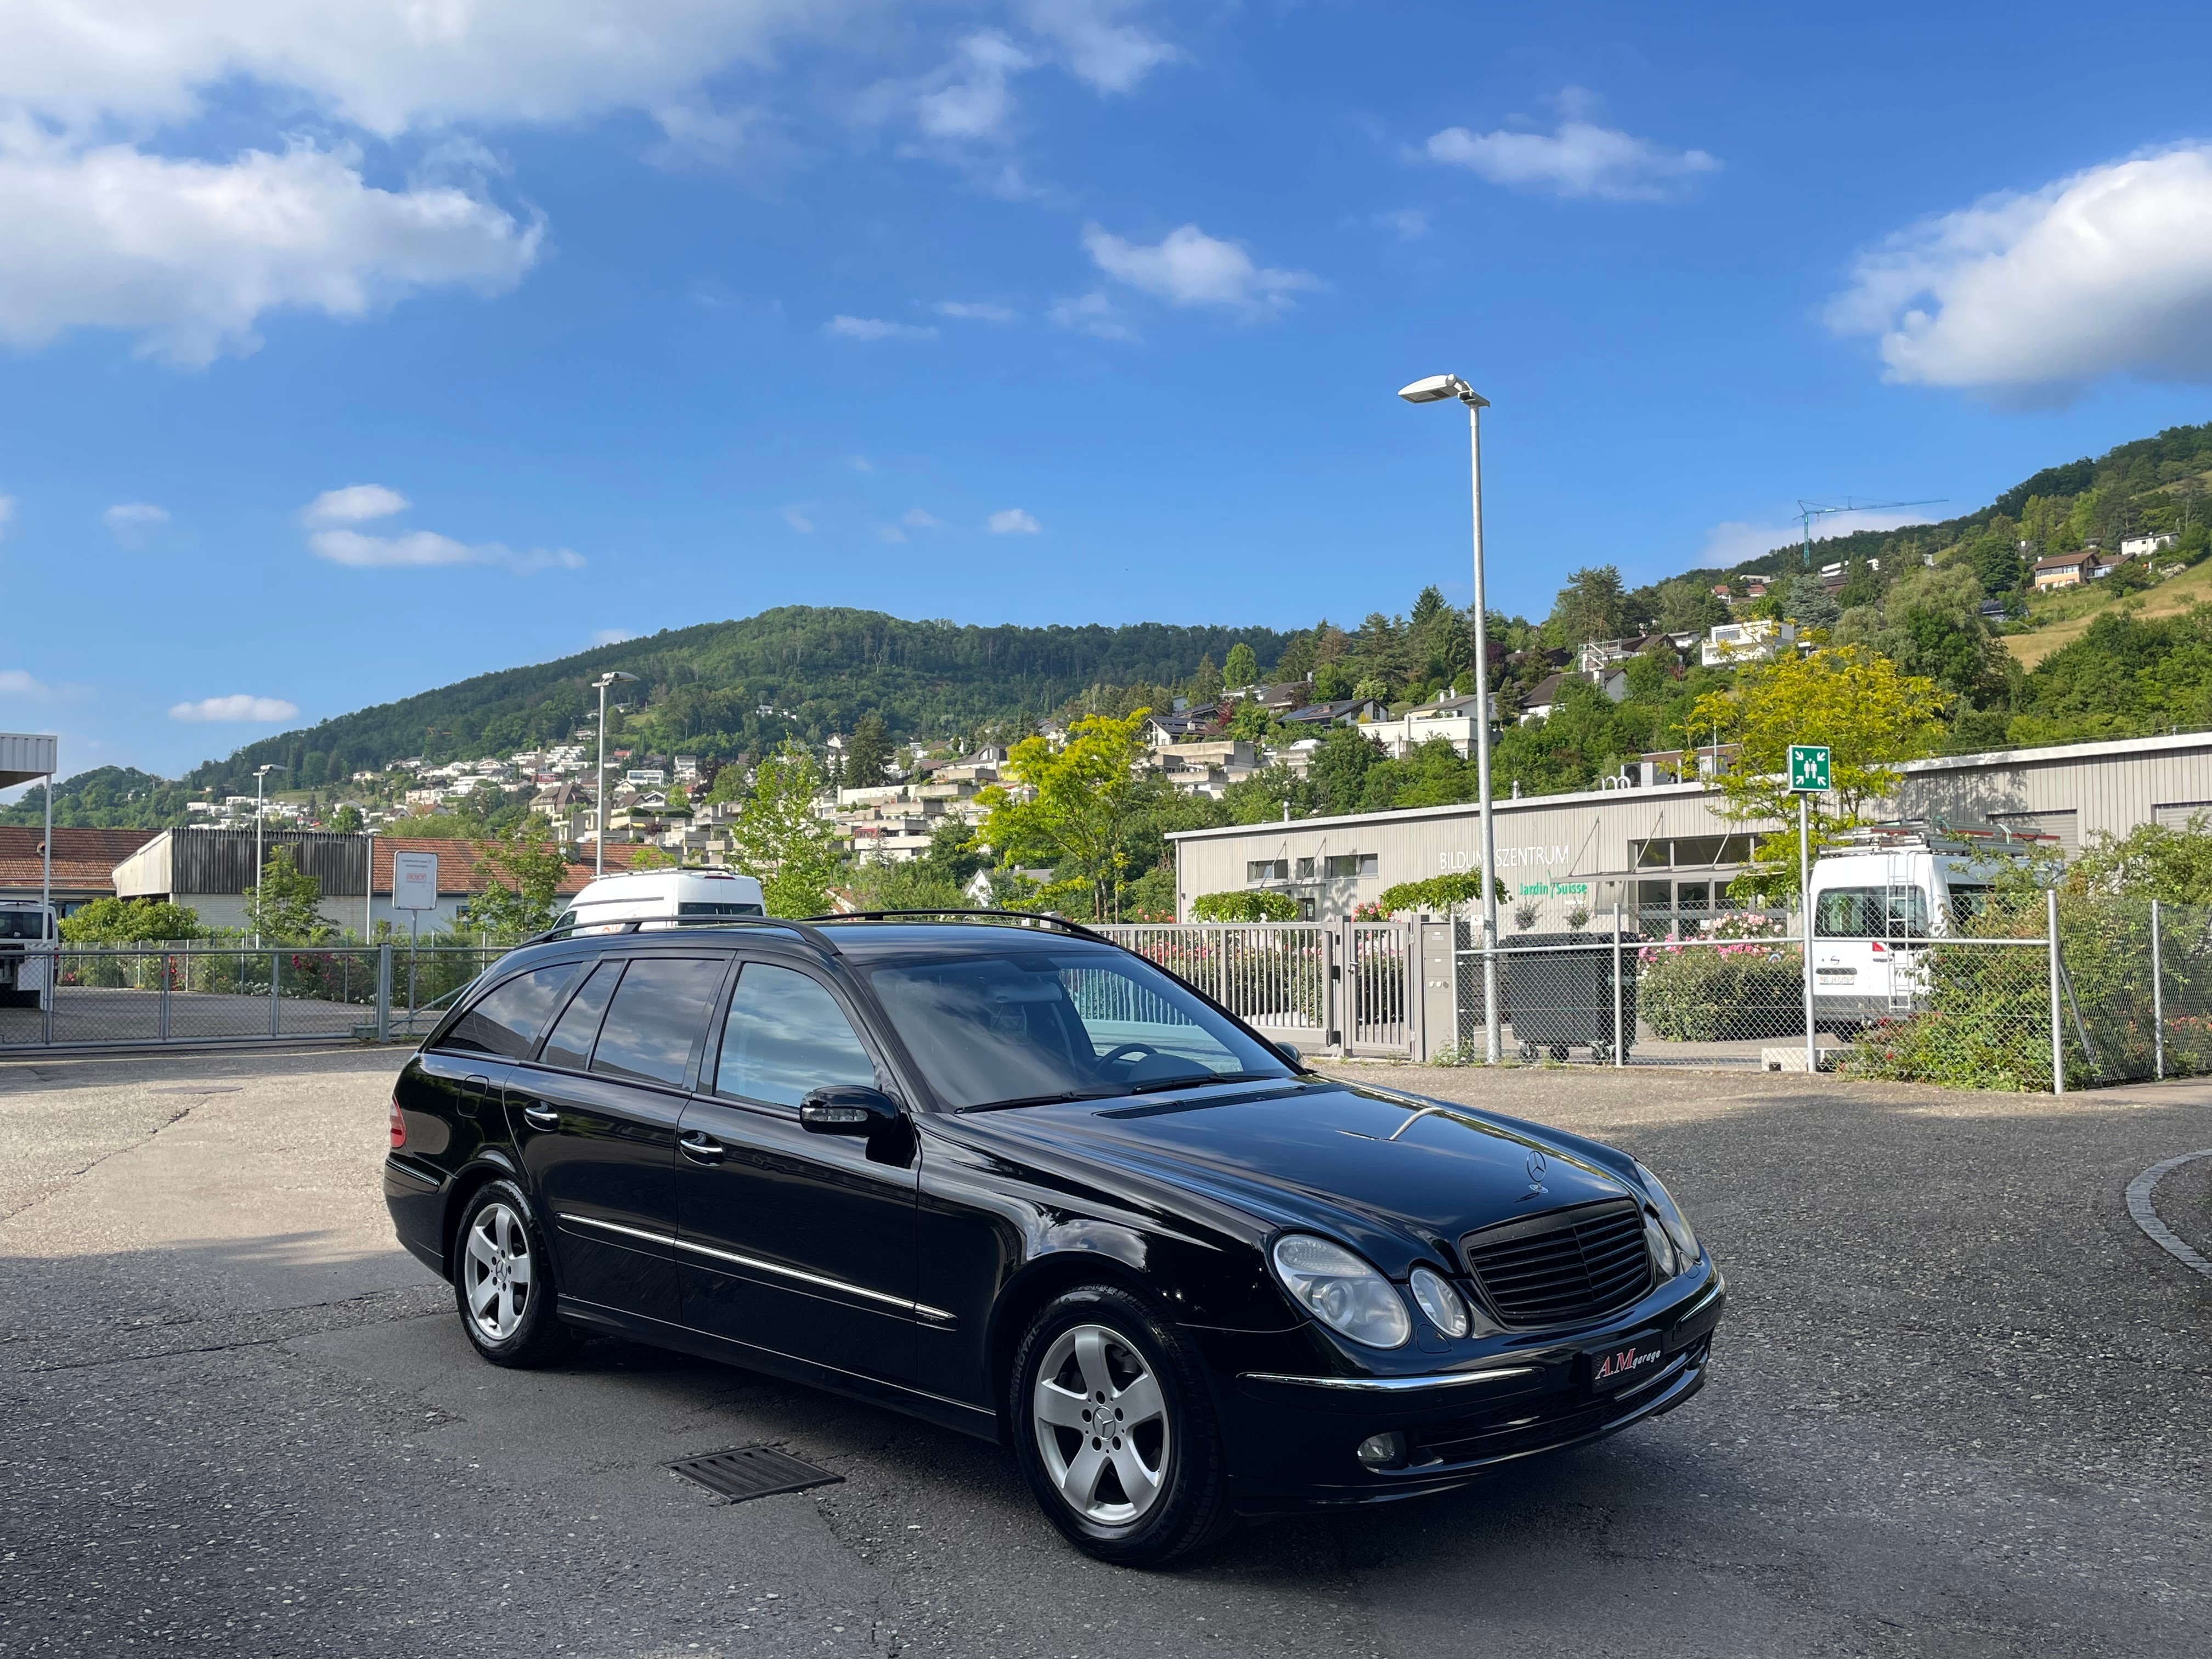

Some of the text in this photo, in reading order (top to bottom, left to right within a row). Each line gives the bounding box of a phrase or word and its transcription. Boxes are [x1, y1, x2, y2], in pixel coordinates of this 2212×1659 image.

[1440, 845, 1570, 870] BILDUNSZENTRUM
[1519, 882, 1587, 895] Jardin Suisse
[1632, 1350, 1661, 1369] garage
